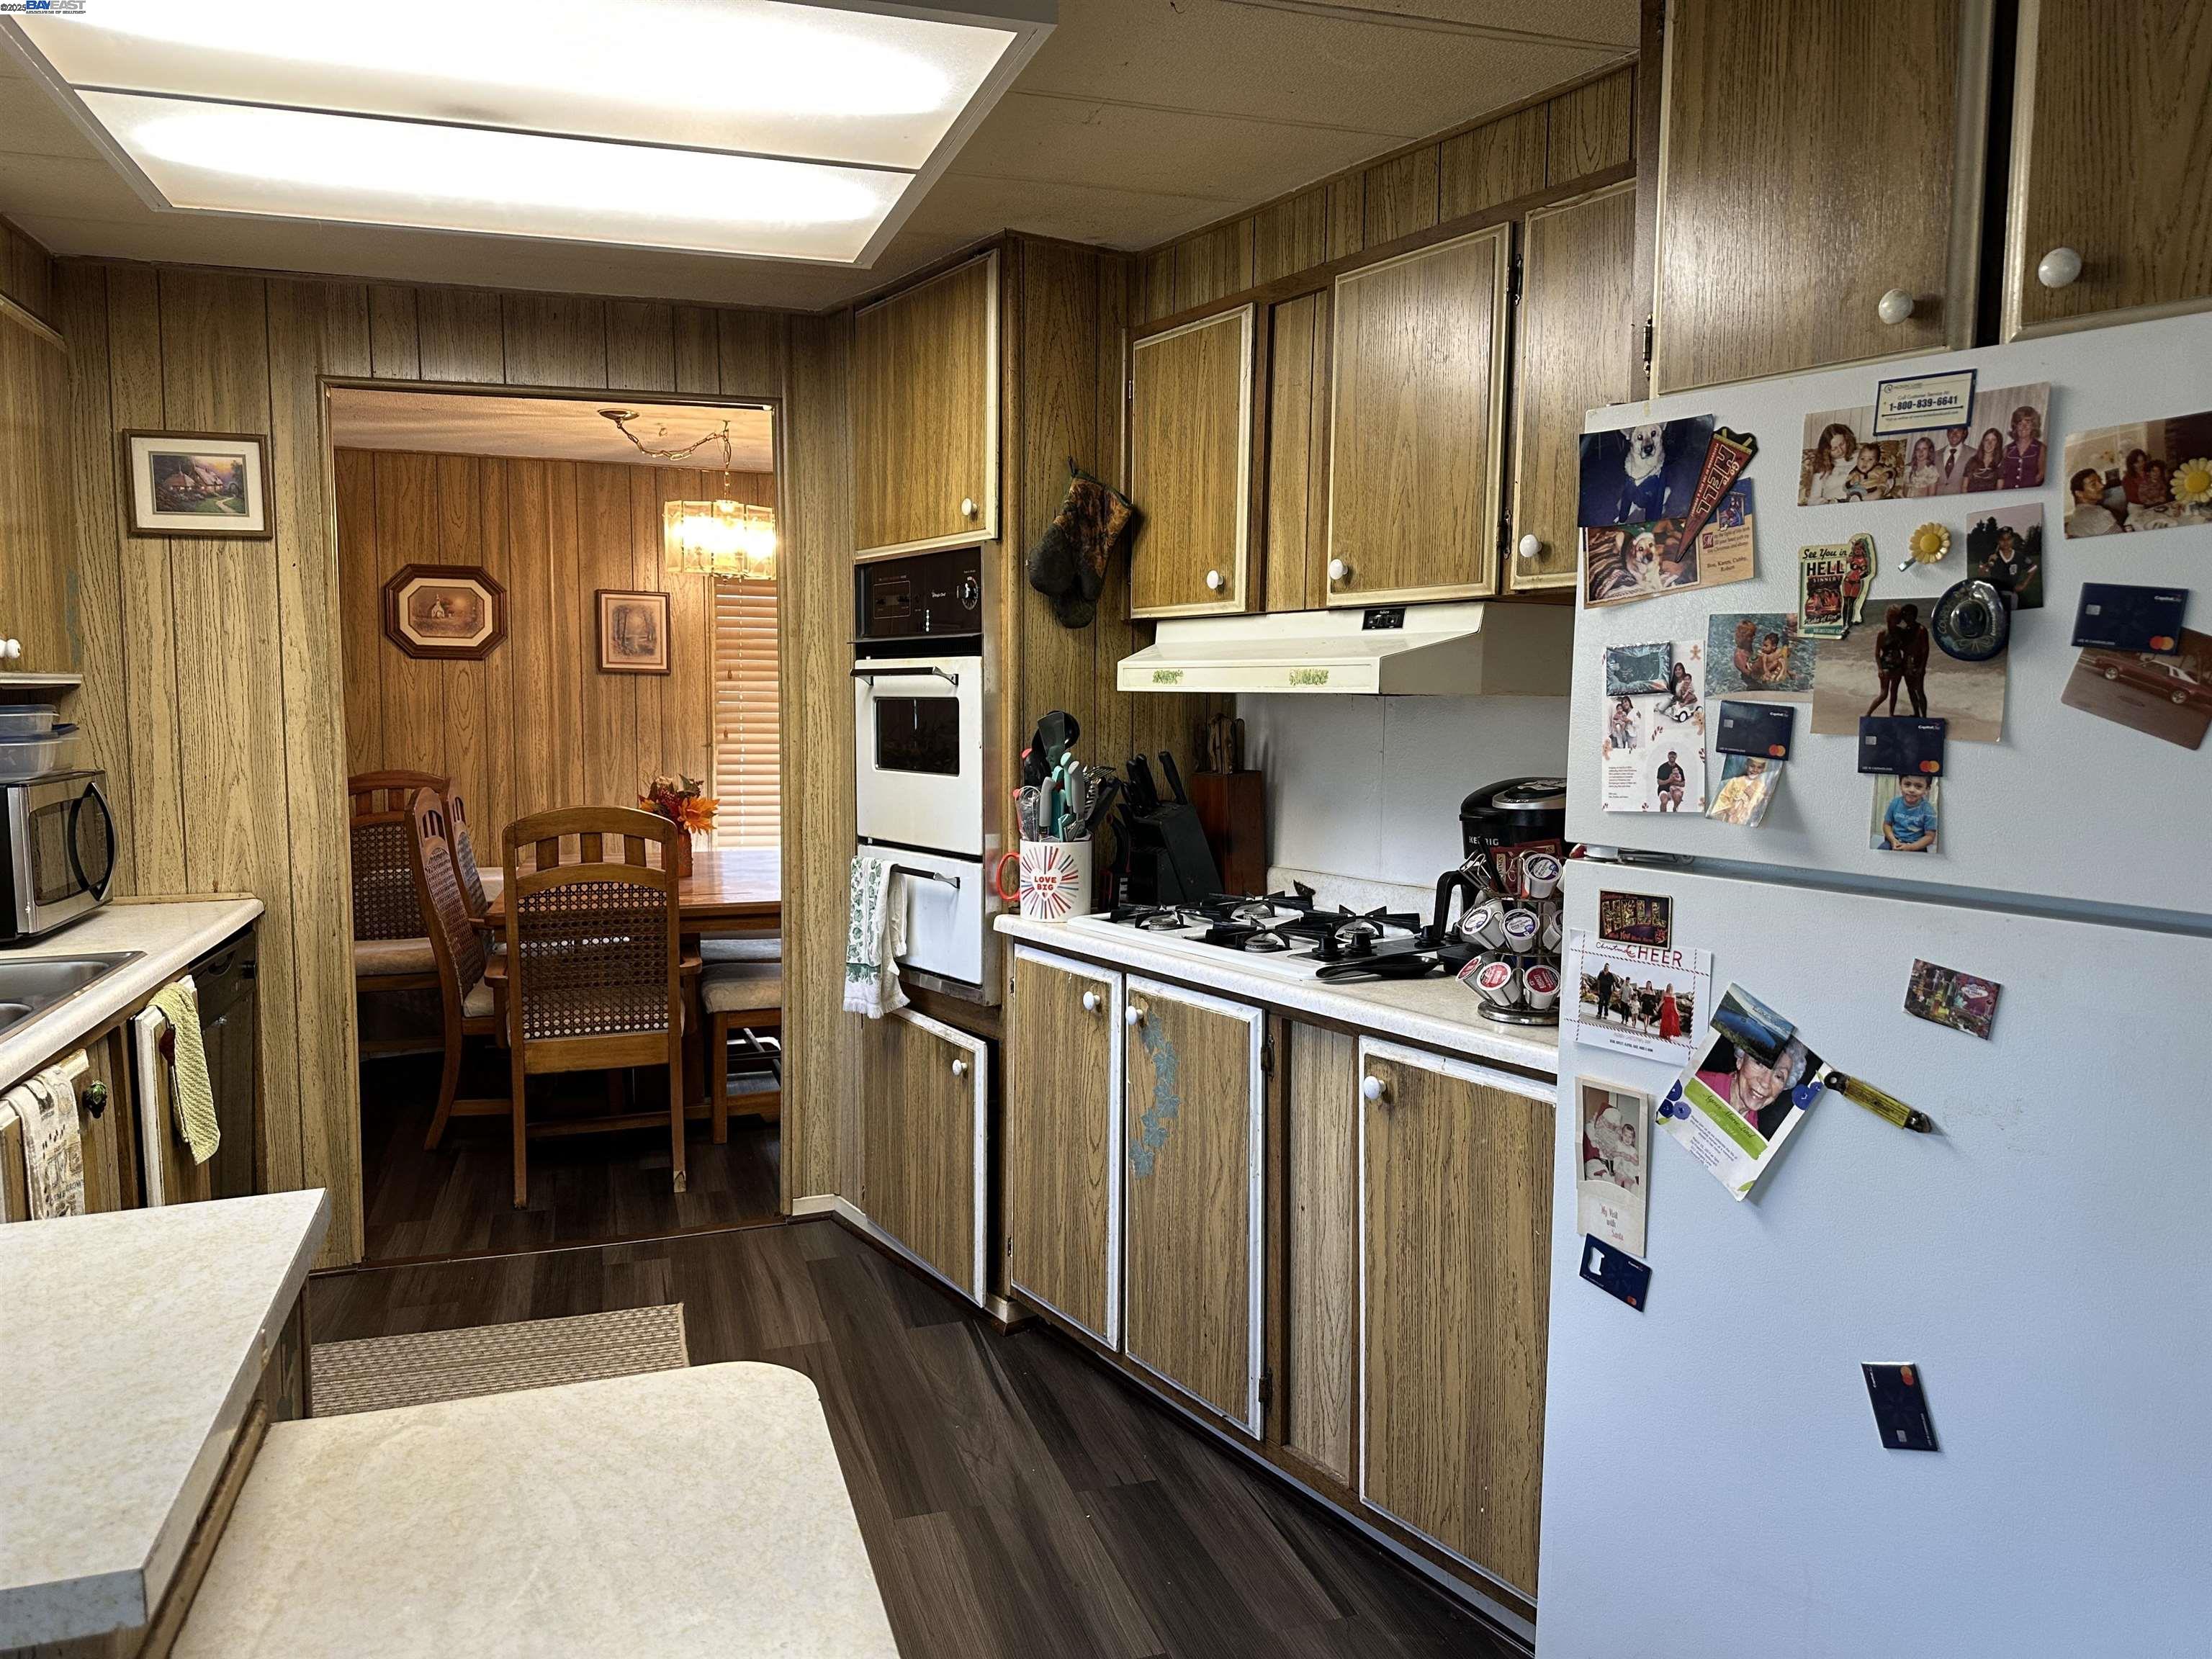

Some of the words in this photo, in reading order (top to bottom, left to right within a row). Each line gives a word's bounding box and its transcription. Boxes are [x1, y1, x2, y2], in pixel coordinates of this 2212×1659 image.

[1889, 395, 1958, 411] 1-800-839-6641
[1696, 444, 1737, 513] HELL
[1802, 549, 1817, 559] See
[1820, 549, 1838, 560] You
[1807, 560, 1845, 577] HELL
[1469, 835, 1498, 846] KERIG
[1627, 945, 1683, 968] CHEER
[1601, 1204, 1608, 1217] My
